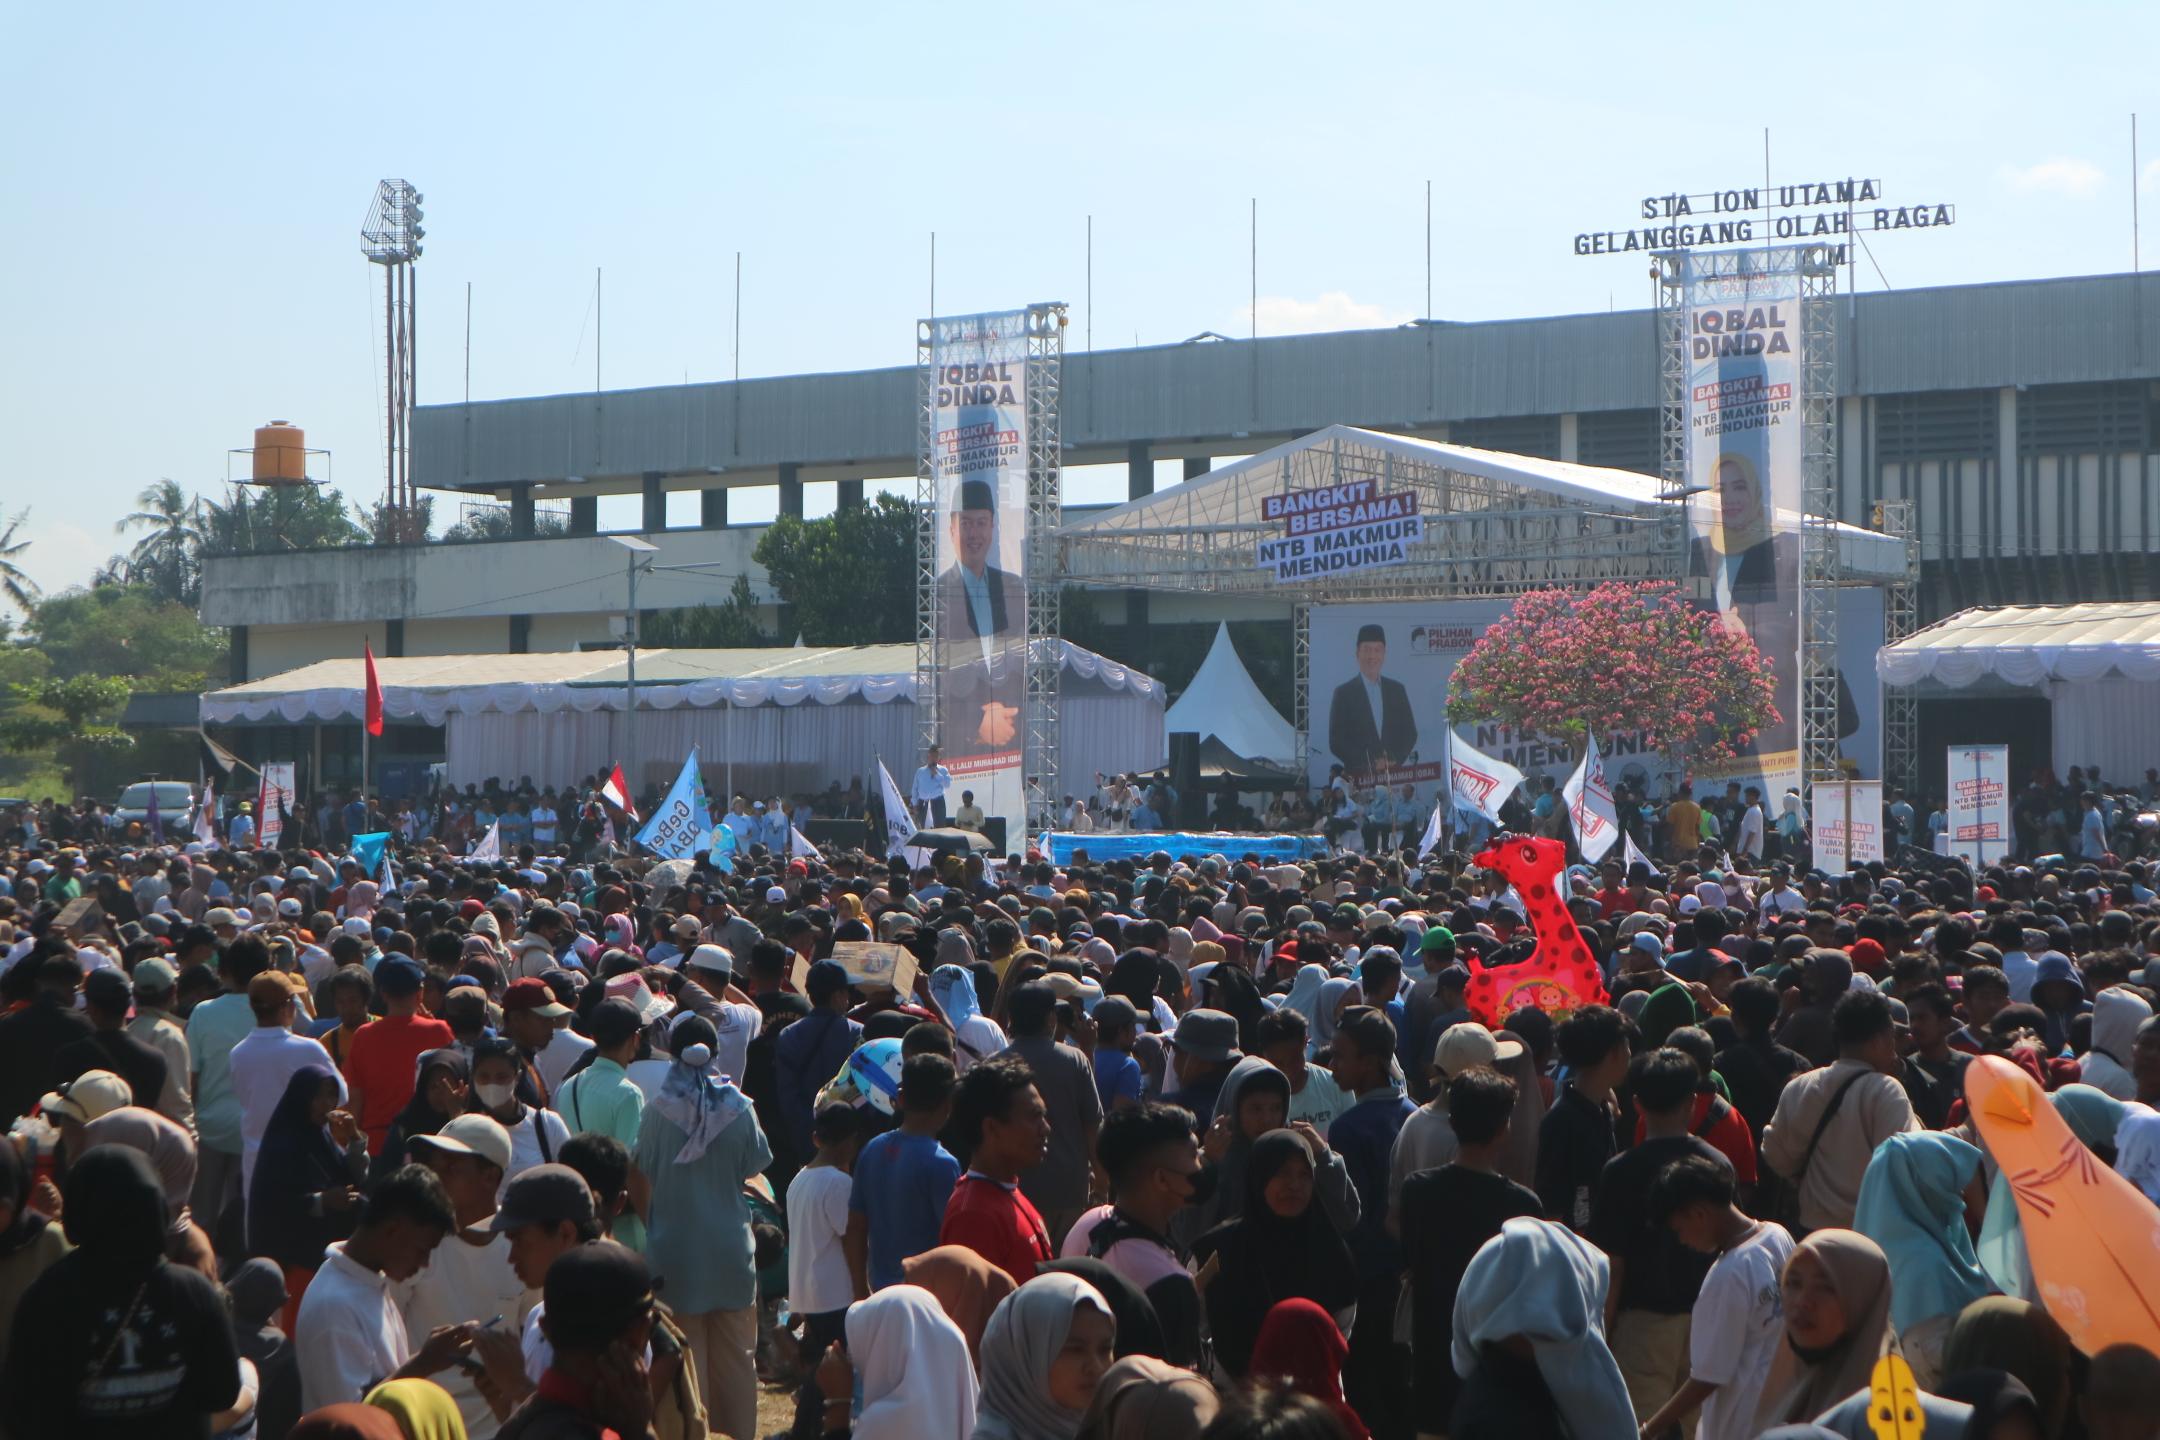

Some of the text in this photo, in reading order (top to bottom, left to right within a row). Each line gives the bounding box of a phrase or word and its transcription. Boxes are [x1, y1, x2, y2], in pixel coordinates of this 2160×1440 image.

[1780, 178, 1878, 208] UTAMA
[1575, 204, 1952, 255] GELANGGANG OLAH RAGA
[1692, 305, 1786, 334] IQBAL
[1693, 331, 1790, 360] DINDA
[938, 361, 1012, 385] IQBAL
[937, 384, 1017, 408] DINDA
[1697, 376, 1760, 400] BANGKIT
[1693, 400, 1791, 427] NTB MAKMUR
[939, 423, 993, 443] BANGKIT
[1704, 415, 1780, 437] MENDUNIA
[937, 444, 1019, 467] NTB MAKMUR
[944, 456, 1009, 476] MENDUNIA
[1267, 482, 1370, 517] BANGKIT
[1260, 519, 1418, 562] NTB MAKMUR
[1280, 542, 1404, 579] MENDUNIA
[1428, 627, 1473, 638] PILIHAN
[1428, 638, 1478, 649] PRABOW
[957, 760, 972, 770] LALU
[1007, 753, 1022, 764] IQBA
[1954, 792, 2003, 805] NTB MAKMUR
[1960, 800, 1998, 811] MENDUNIA
